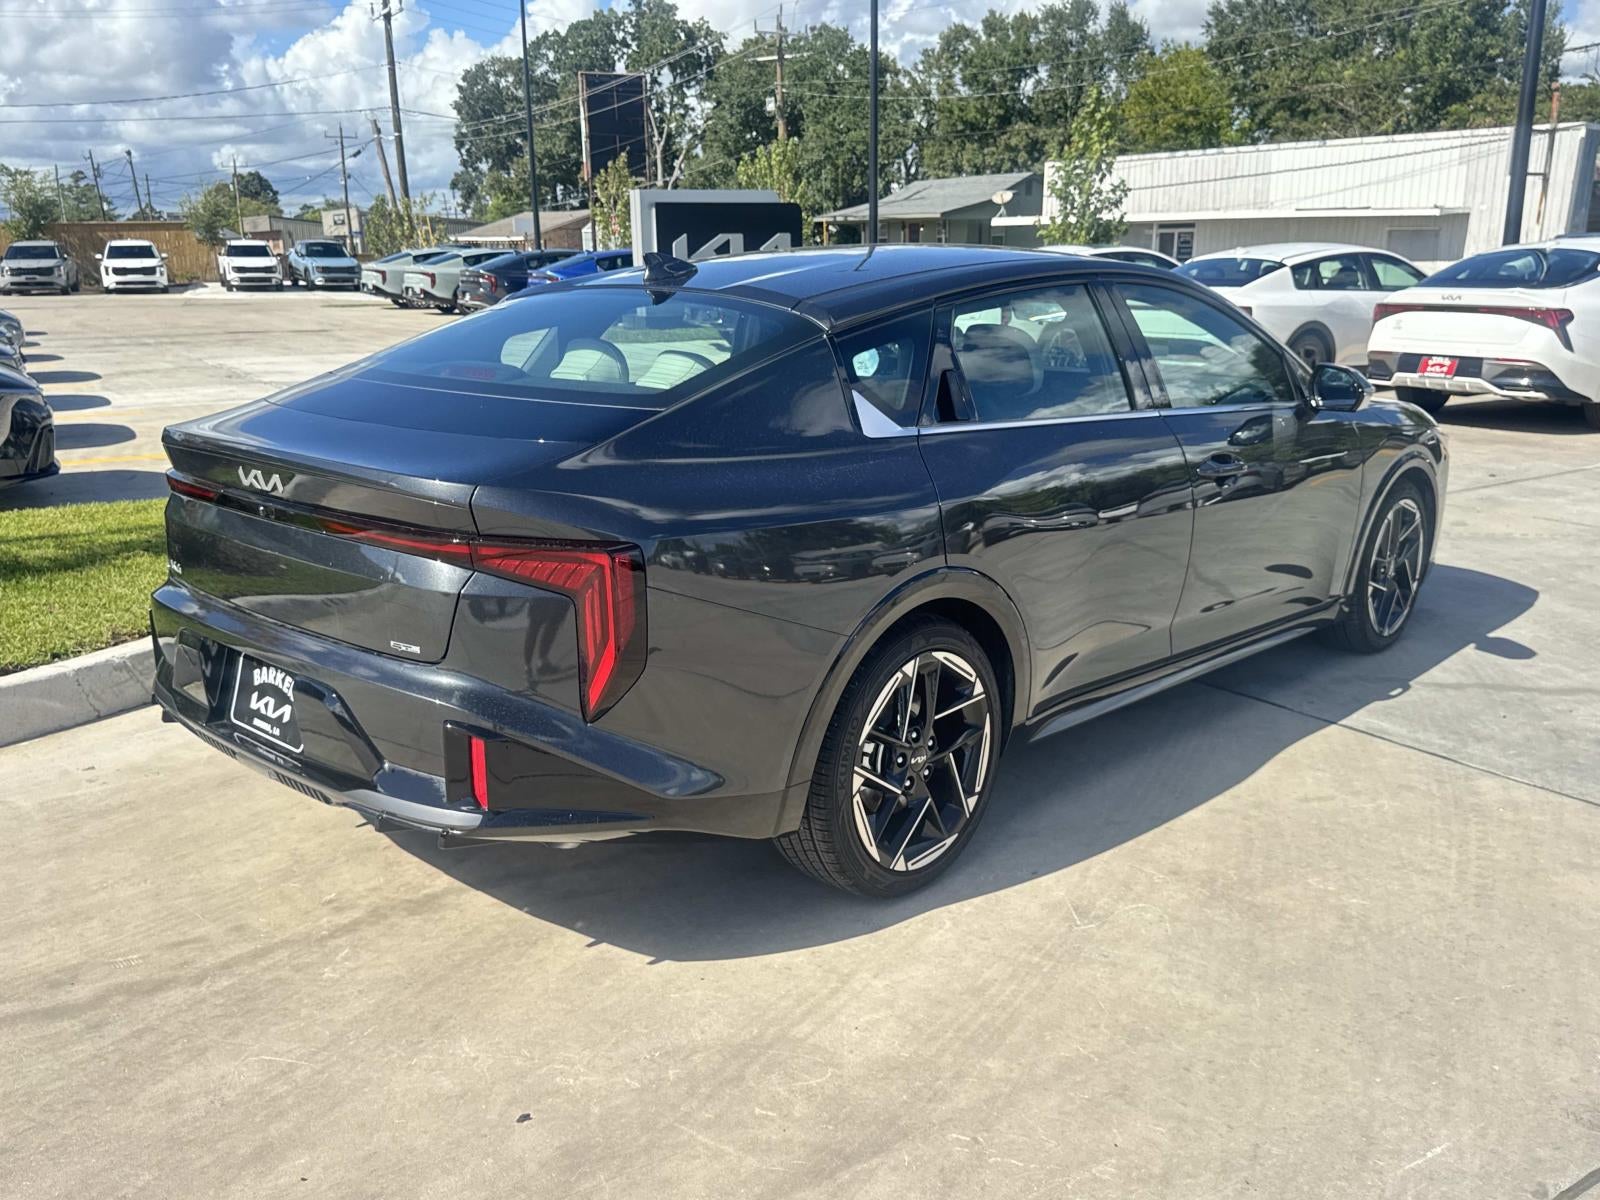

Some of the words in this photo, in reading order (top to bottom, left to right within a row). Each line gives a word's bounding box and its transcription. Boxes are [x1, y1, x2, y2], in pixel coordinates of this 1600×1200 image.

[238, 465, 284, 494] KIA
[249, 690, 292, 724] KIA
[838, 717, 859, 791] KUMHO
